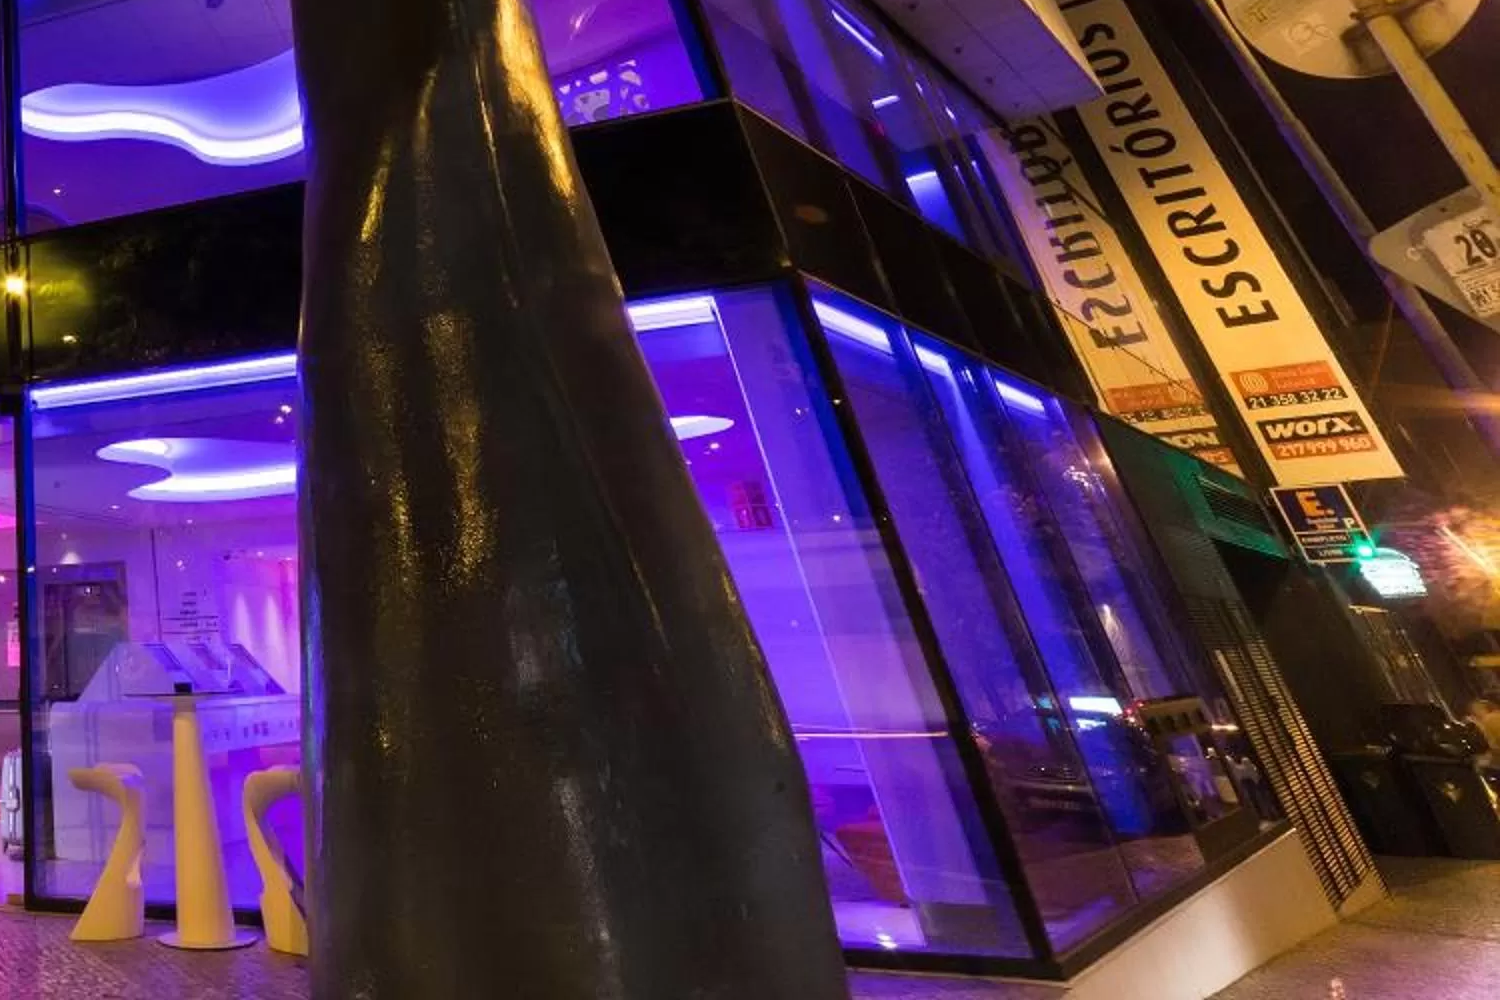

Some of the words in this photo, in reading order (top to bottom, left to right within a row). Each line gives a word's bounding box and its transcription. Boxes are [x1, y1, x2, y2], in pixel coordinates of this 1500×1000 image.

[1080, 23, 1279, 329] ESCRITÓRIOS
[1250, 396, 1268, 410] 21
[1343, 517, 1356, 530] P
